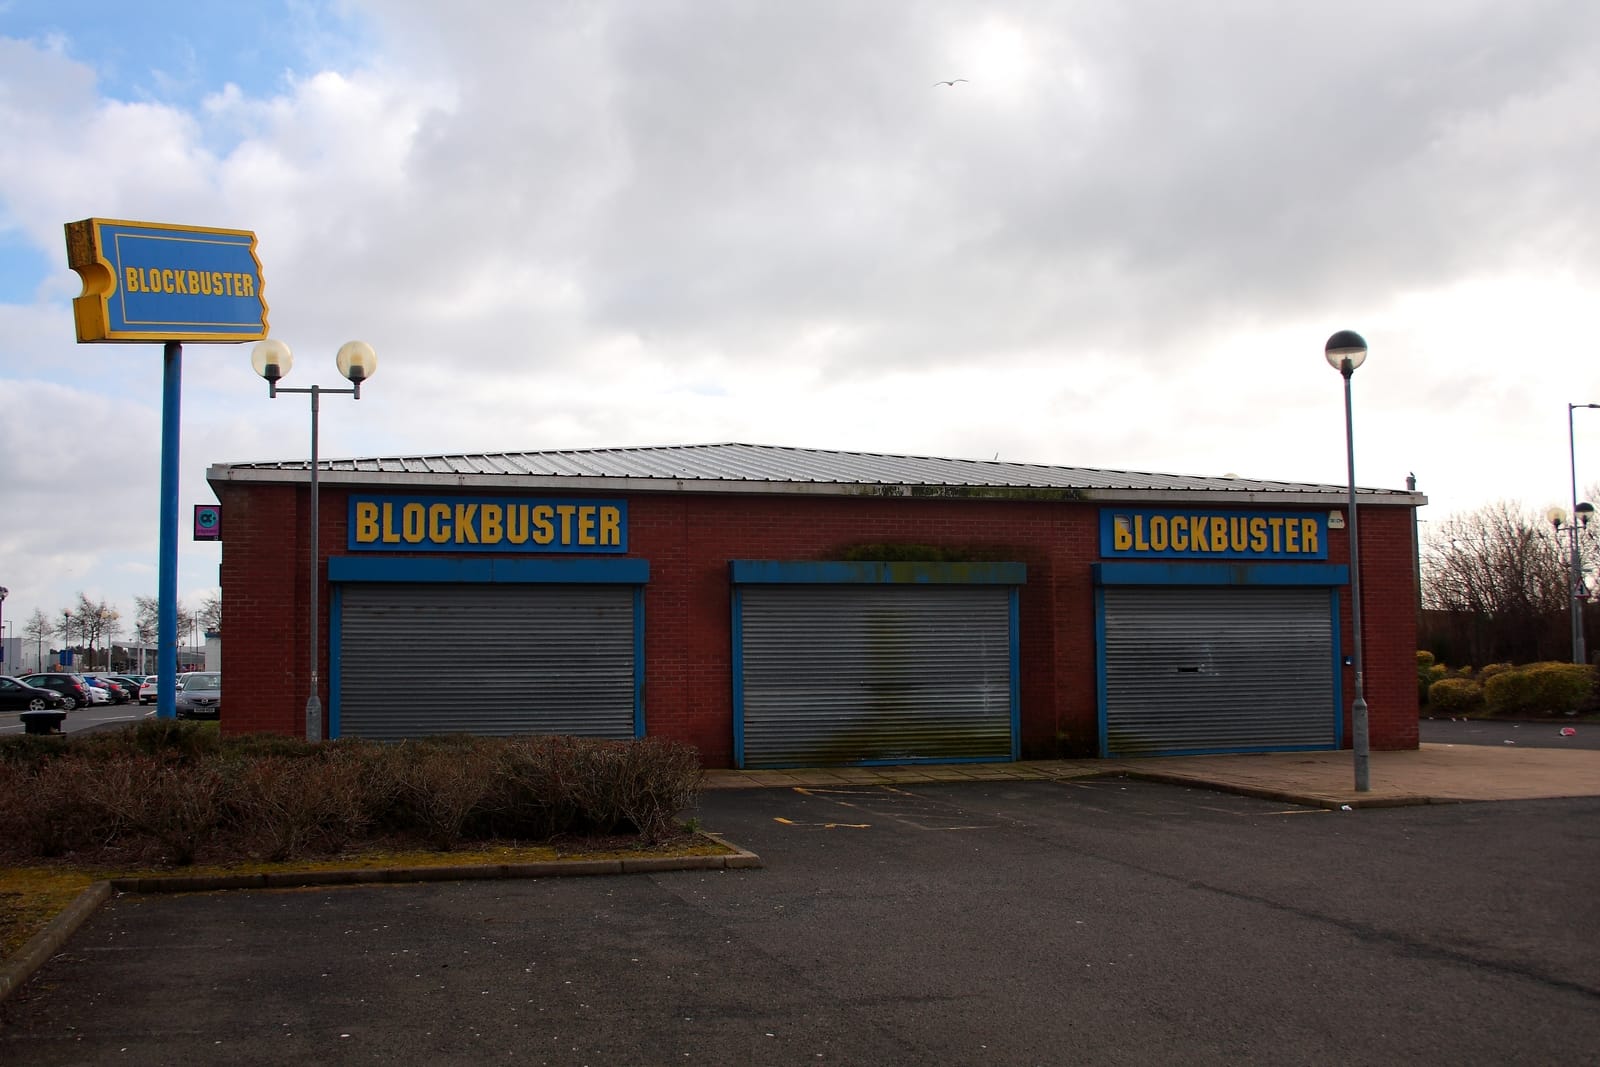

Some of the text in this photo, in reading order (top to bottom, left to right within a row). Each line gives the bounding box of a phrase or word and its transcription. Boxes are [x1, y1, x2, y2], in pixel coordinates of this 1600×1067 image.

[125, 267, 254, 297] BLOCKBUSTER
[356, 502, 621, 546] BLOCKBUSTER
[1113, 514, 1319, 553] BLOCKBUSTER
